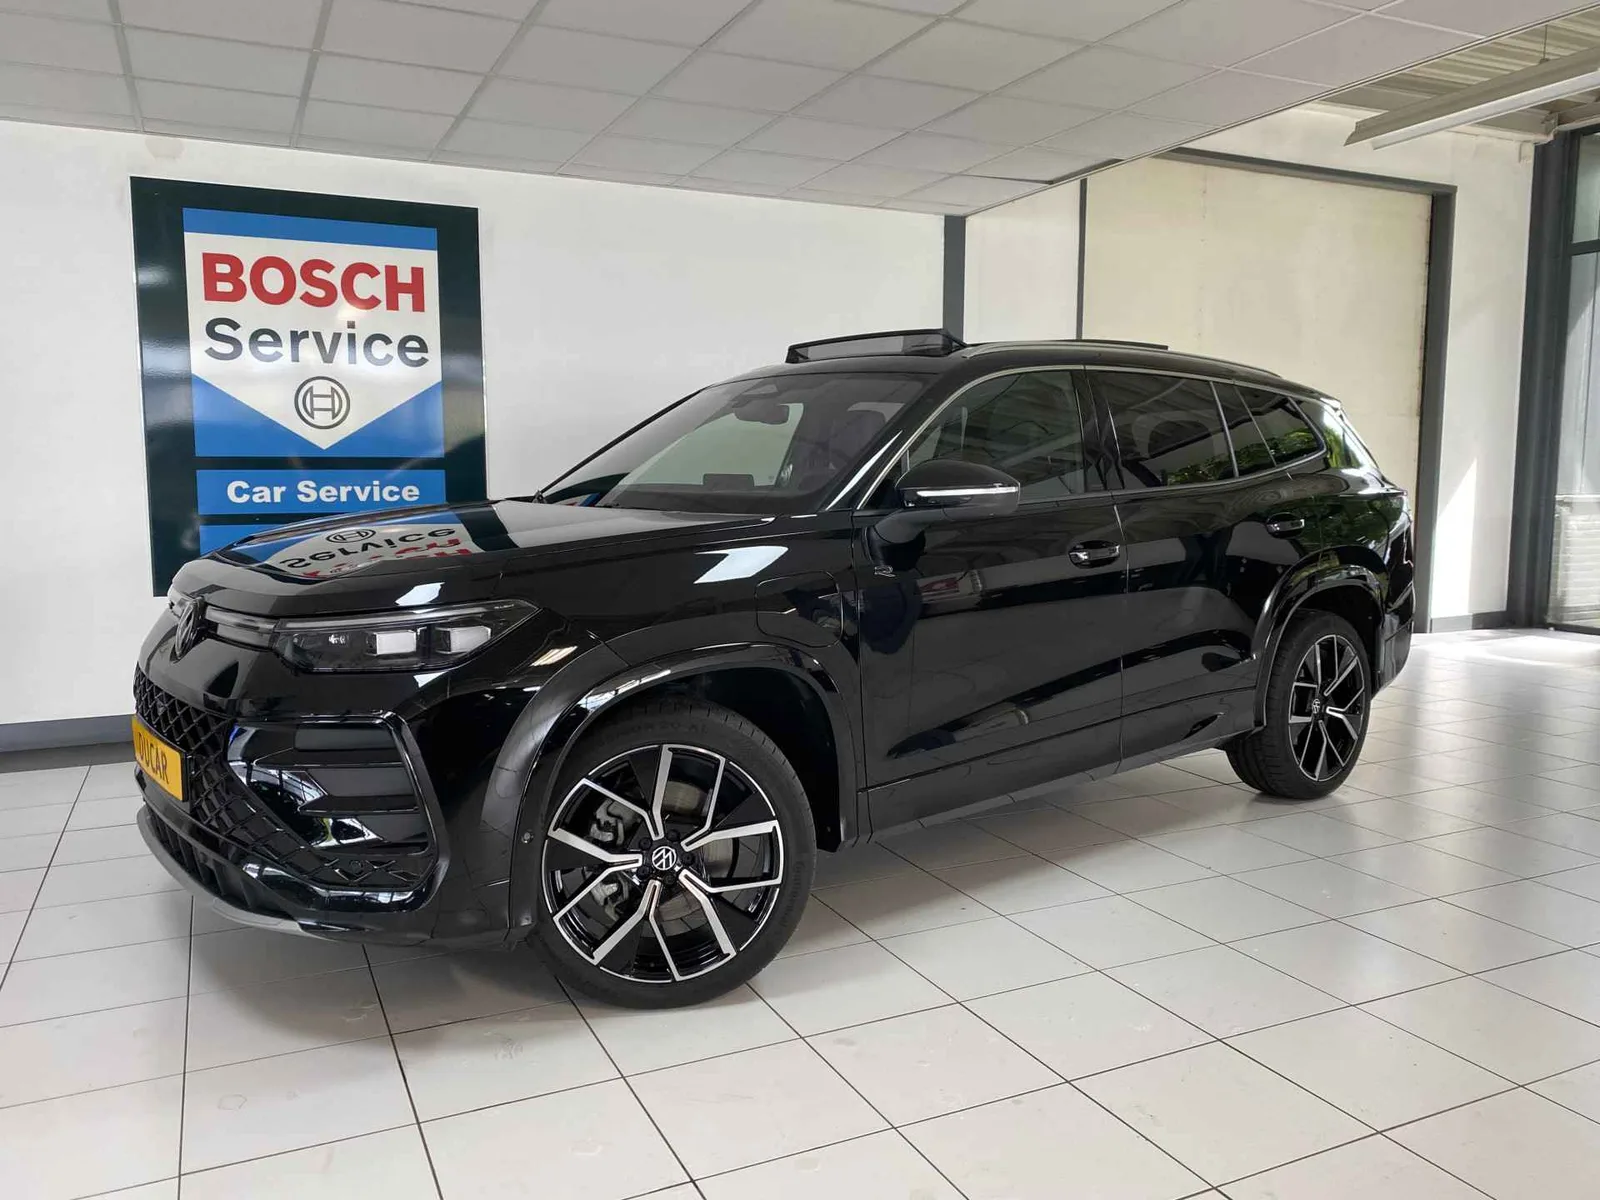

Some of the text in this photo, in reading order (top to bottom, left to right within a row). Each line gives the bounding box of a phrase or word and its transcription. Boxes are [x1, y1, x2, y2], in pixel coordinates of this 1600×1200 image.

[202, 252, 426, 312] BOSCH
[204, 317, 429, 367] Service
[226, 480, 420, 504] Car Service
